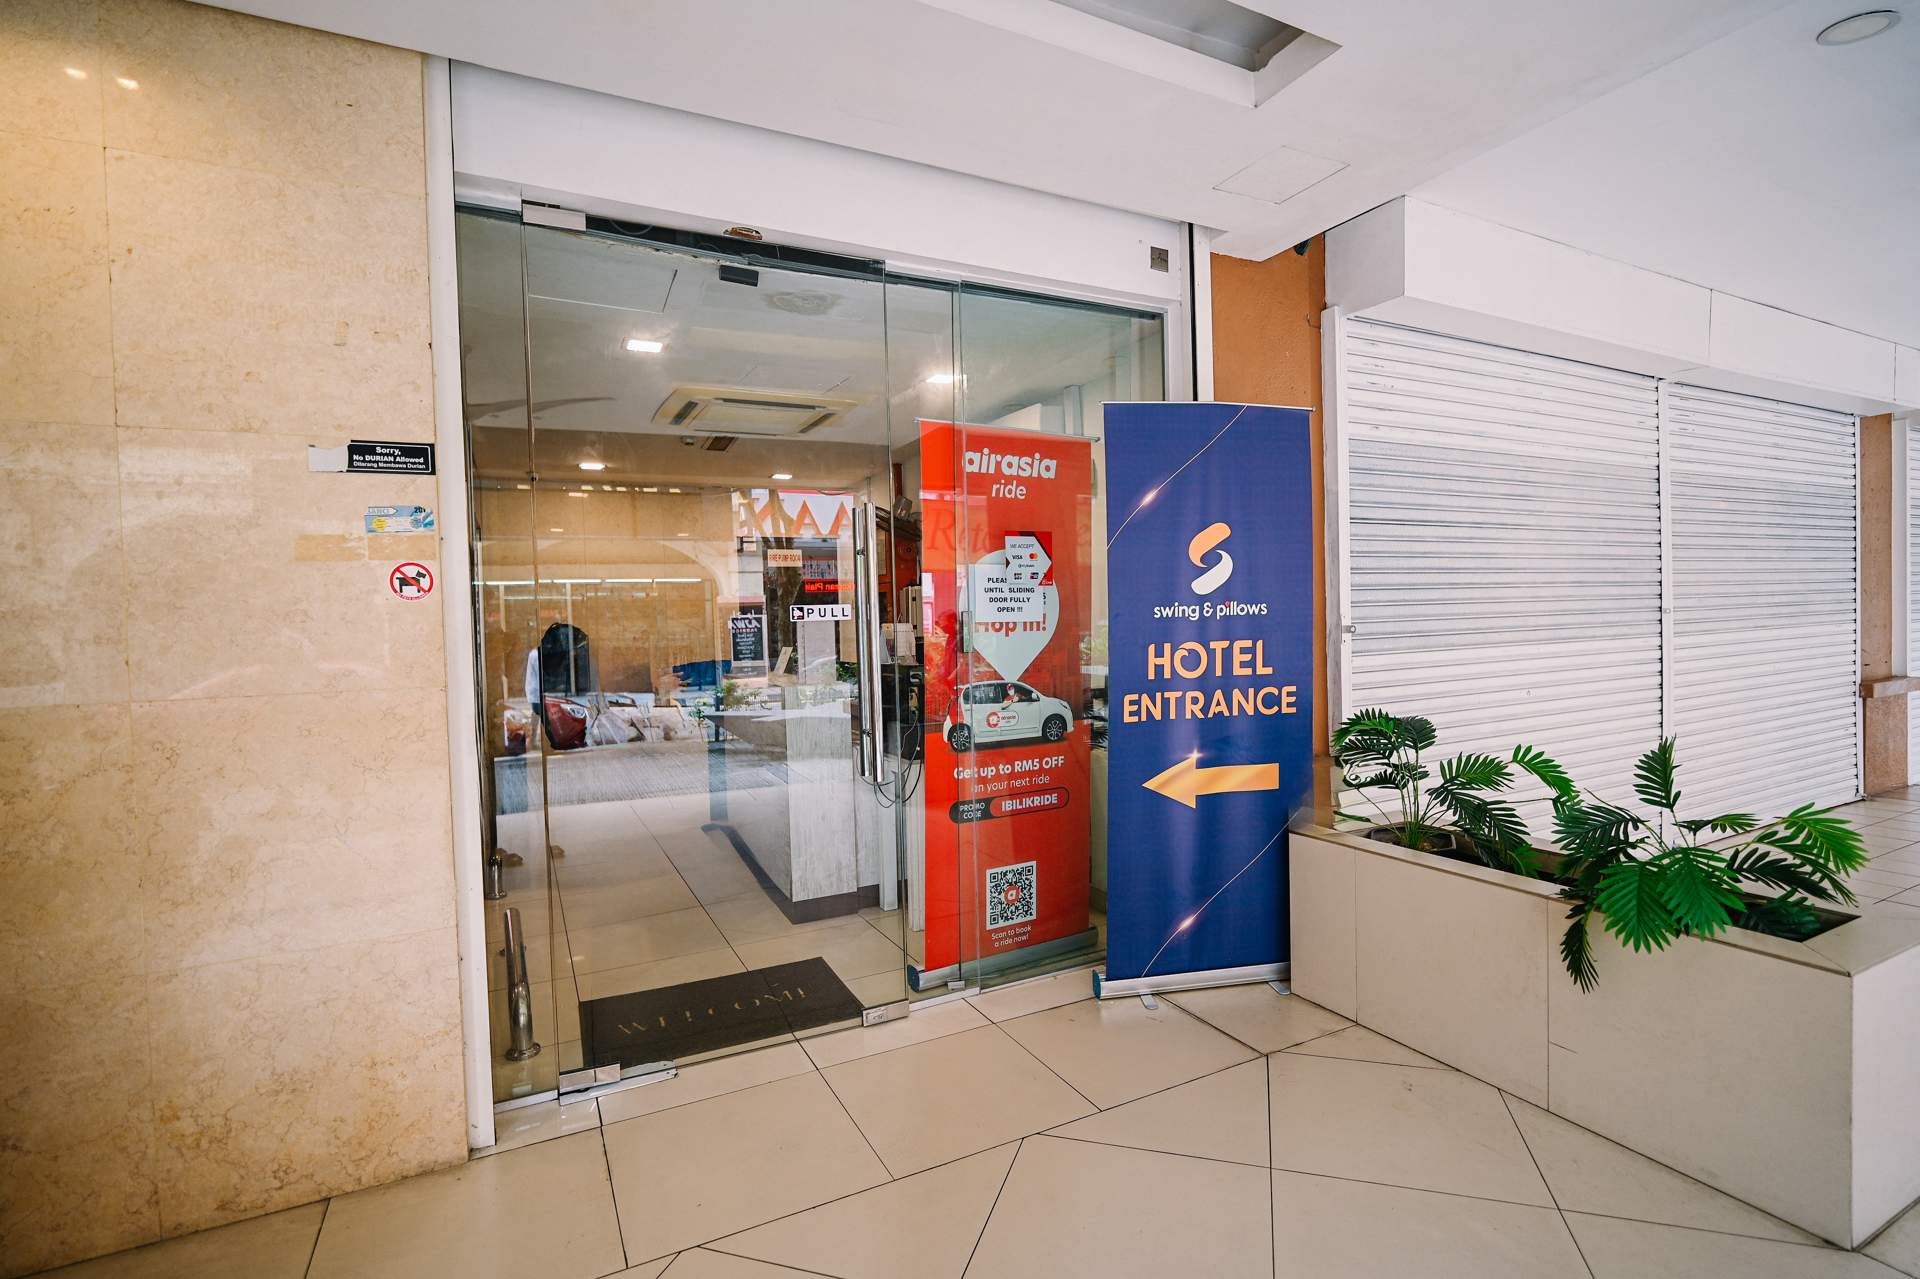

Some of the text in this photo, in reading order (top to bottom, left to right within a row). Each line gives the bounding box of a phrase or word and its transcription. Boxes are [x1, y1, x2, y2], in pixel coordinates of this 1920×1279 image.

[375, 446, 401, 455] Sorry,
[962, 447, 1057, 479] airasia
[991, 479, 1027, 499] ride
[806, 607, 849, 618] PULL
[1153, 600, 1268, 621] swing & pillows
[1147, 639, 1273, 680] HOTEL
[1123, 685, 1297, 723] ENTRANCE
[953, 756, 1065, 779] Get up to RM5 OFF
[987, 781, 1007, 793] your
[1010, 778, 1030, 788] next
[1032, 774, 1050, 785] ride
[1001, 793, 1058, 811] IBILIKRIDE
[991, 931, 1007, 940] Scan
[1016, 925, 1032, 934] book
[1013, 934, 1029, 943] now!
